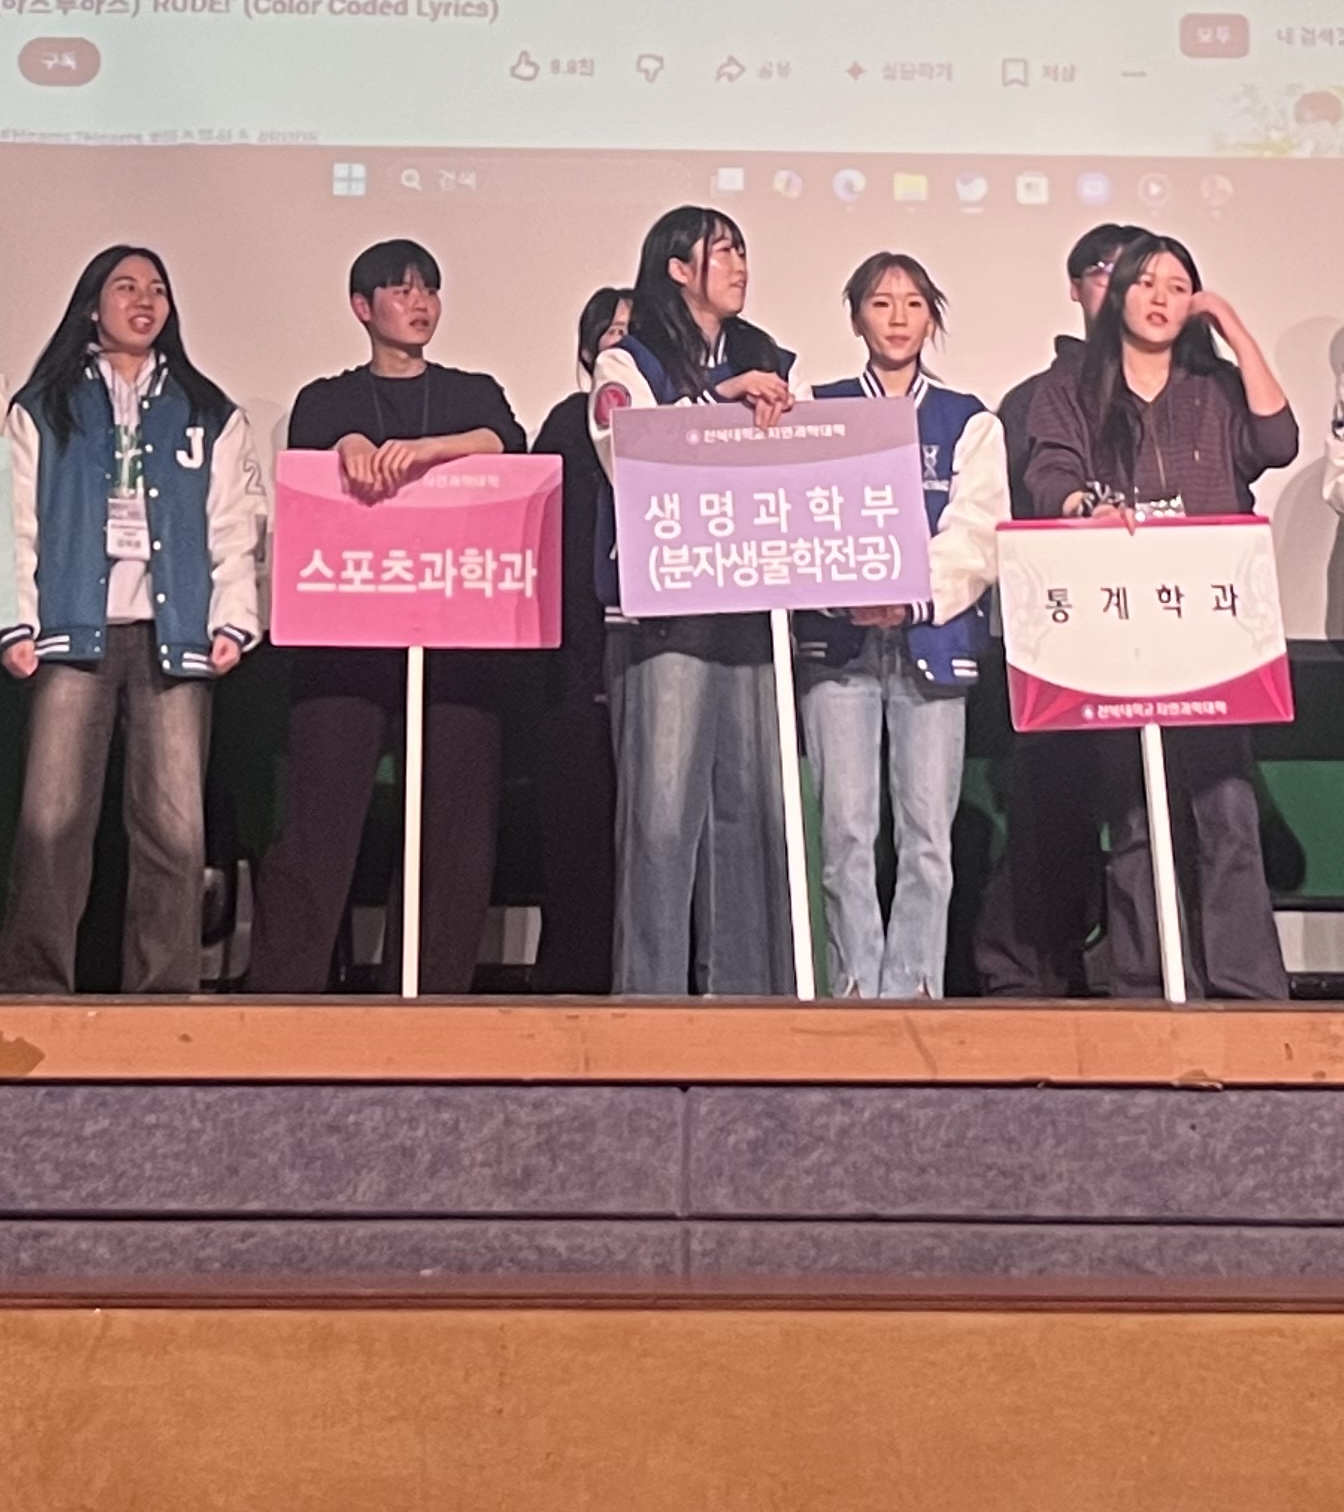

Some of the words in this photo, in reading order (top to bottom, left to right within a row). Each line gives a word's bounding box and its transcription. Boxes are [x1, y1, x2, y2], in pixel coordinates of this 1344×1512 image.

[175, 426, 205, 469] J
[296, 548, 538, 600] 스포츠과학과
[649, 534, 902, 593] (분자생물학전공)
